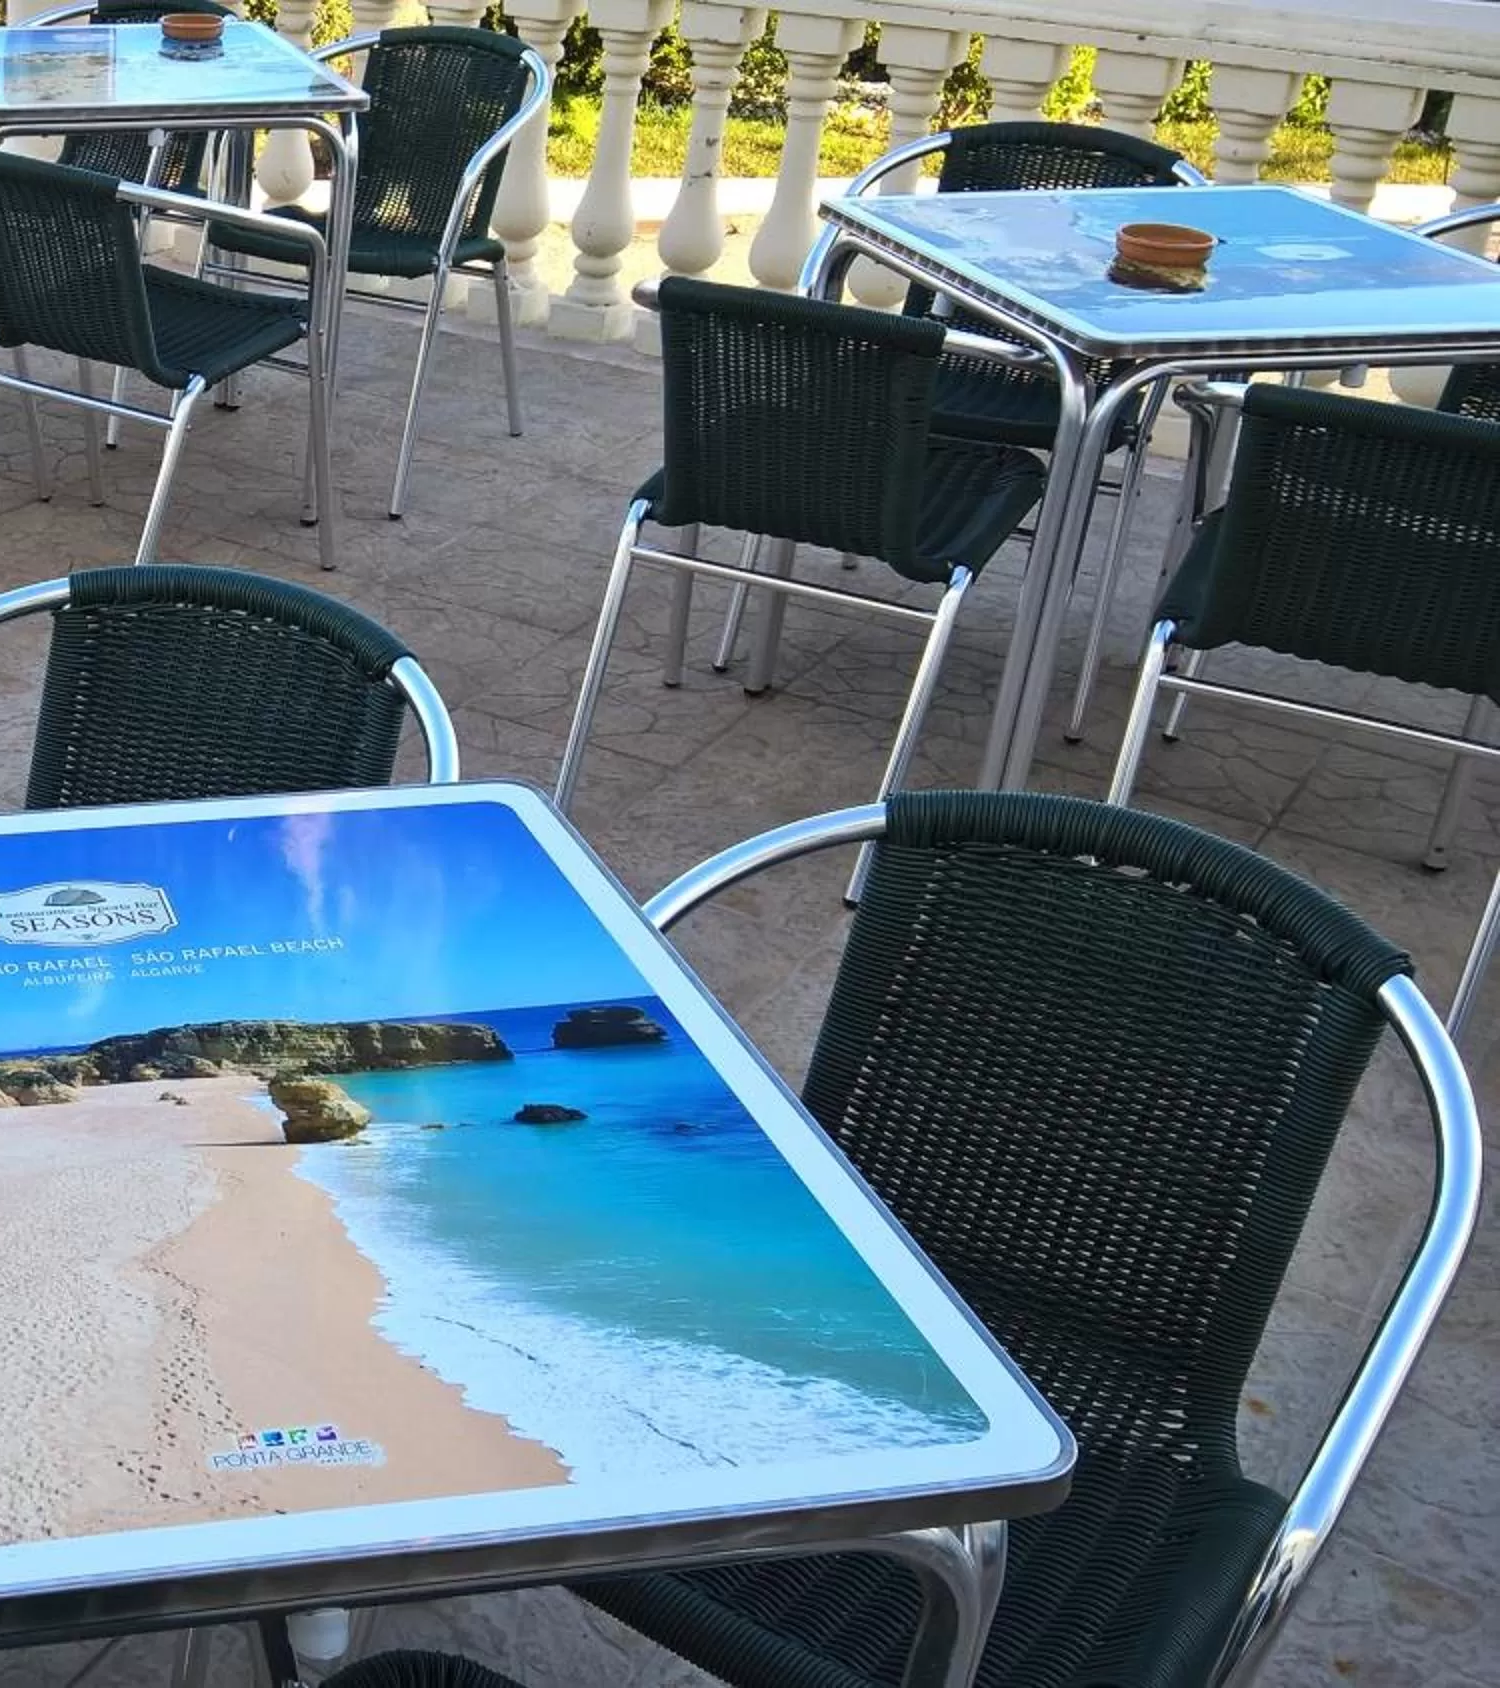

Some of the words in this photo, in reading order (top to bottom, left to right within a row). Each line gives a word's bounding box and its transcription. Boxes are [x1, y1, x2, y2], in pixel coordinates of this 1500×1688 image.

[87, 902, 132, 914] Sports
[135, 899, 160, 910] Bar
[10, 909, 157, 935] SEASONS
[26, 954, 112, 973] RAFAEL
[131, 949, 175, 966] SÃO
[181, 942, 266, 961] RAFAEL
[269, 936, 344, 954] BEACH
[23, 969, 117, 988] ALBUFEIRA
[131, 962, 203, 978] ALGARVE
[213, 1449, 283, 1469] PONTA
[285, 1440, 371, 1461] GRANDE
